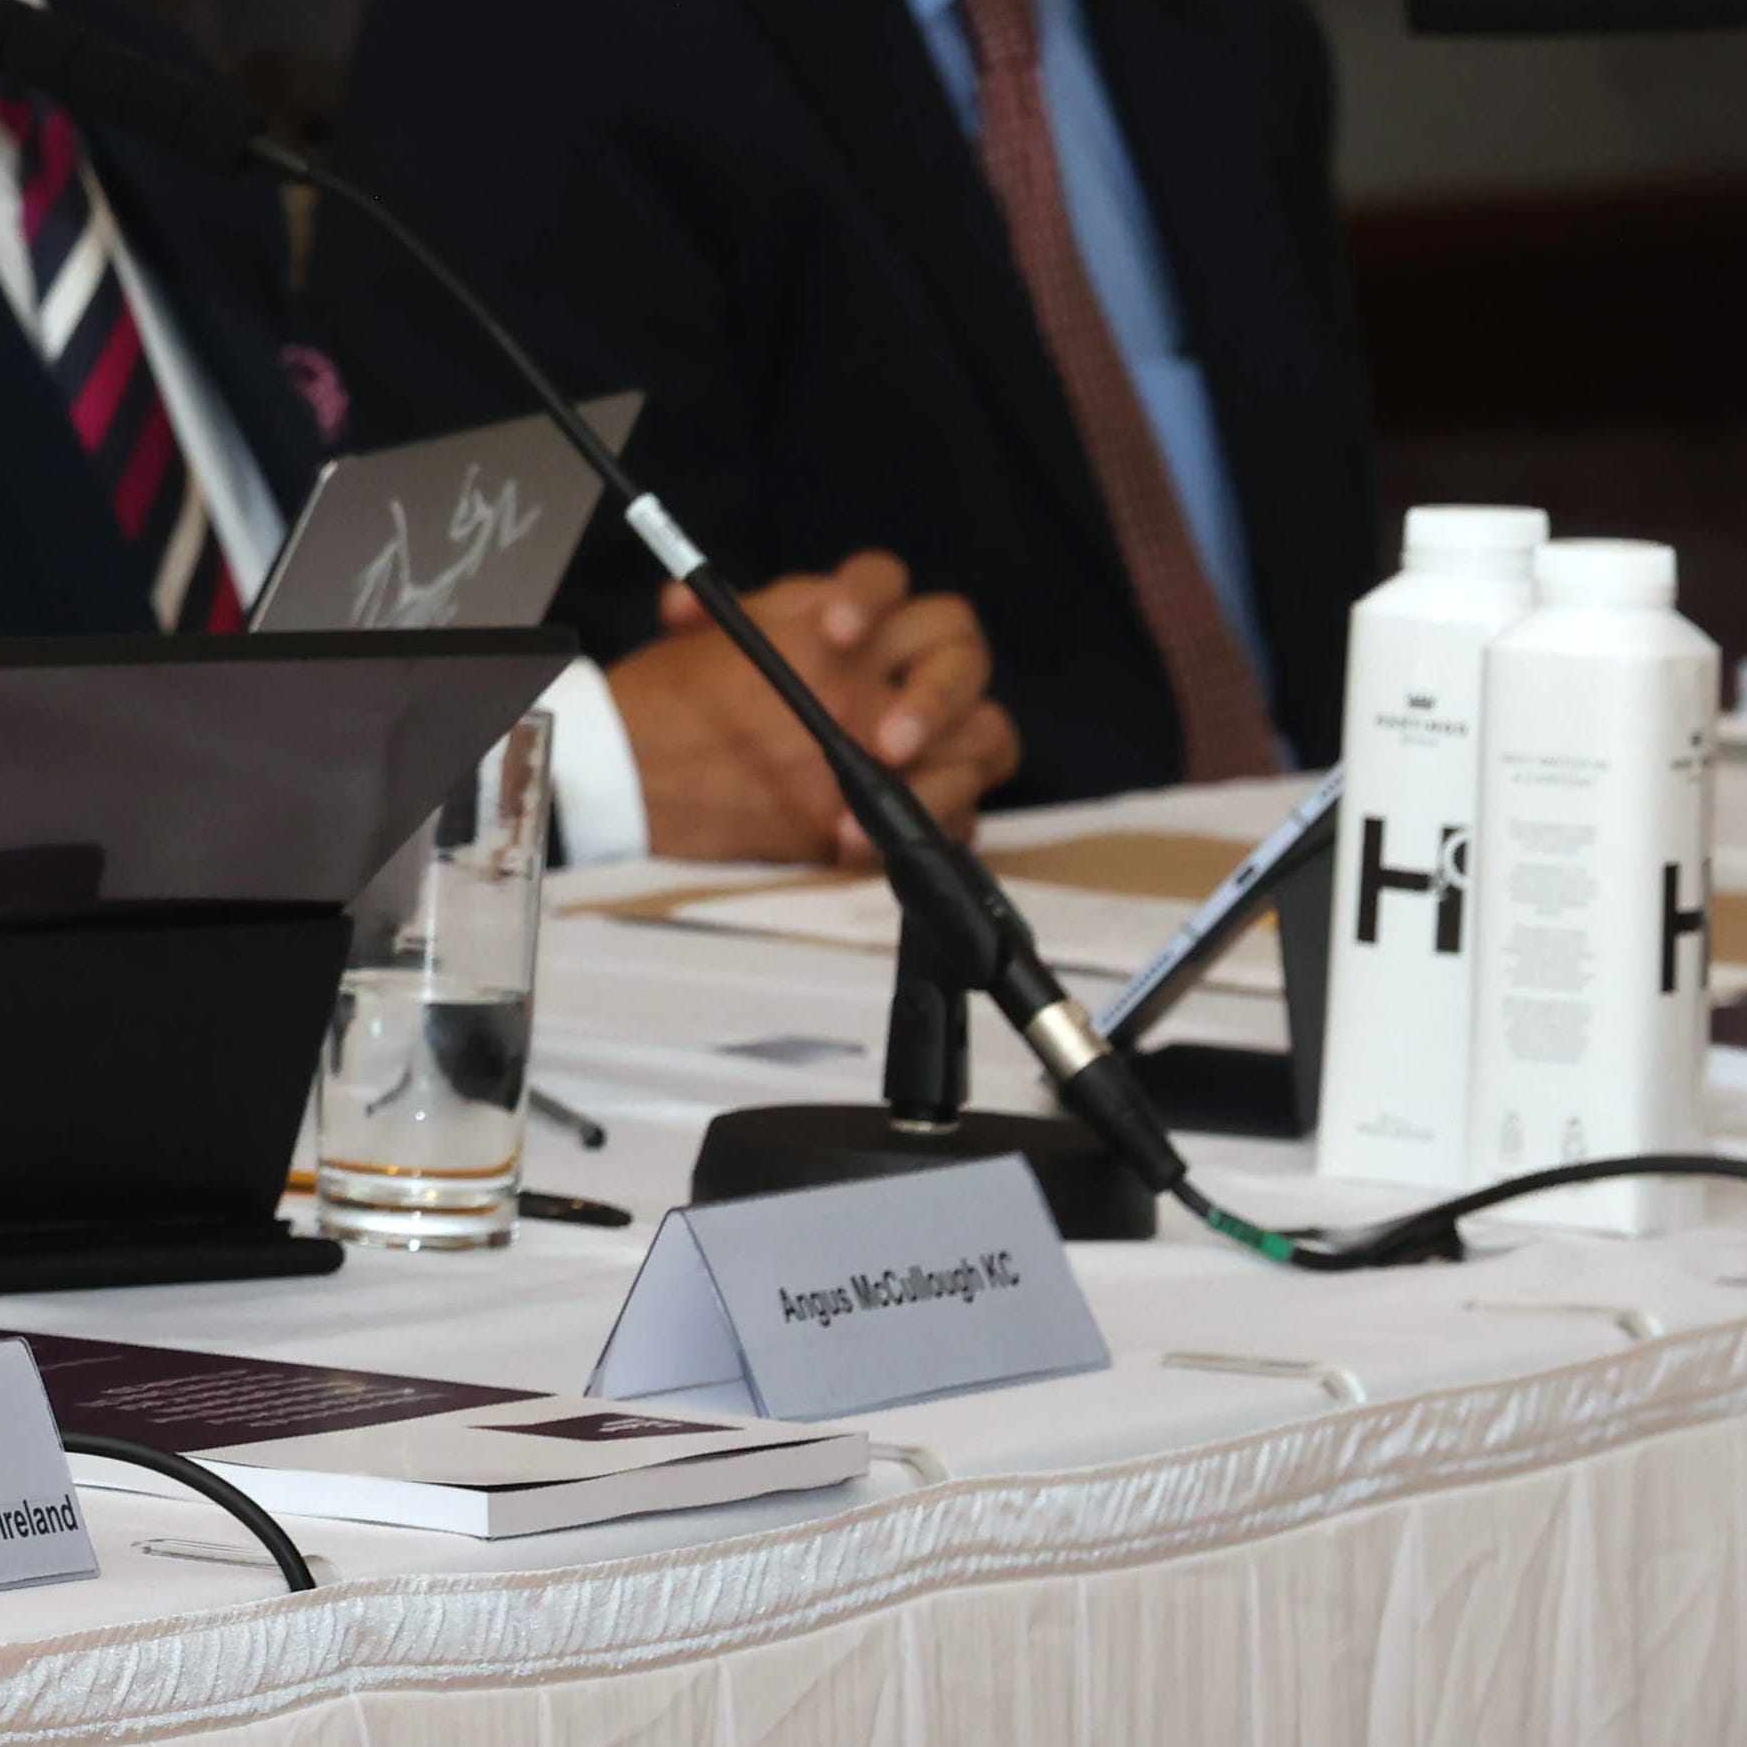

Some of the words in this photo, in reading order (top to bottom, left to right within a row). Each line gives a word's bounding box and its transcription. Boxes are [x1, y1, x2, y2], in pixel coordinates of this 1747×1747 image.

[778, 1286, 854, 1328] Angus
[850, 1256, 987, 1311] McCullough
[979, 1250, 1021, 1289] KC
